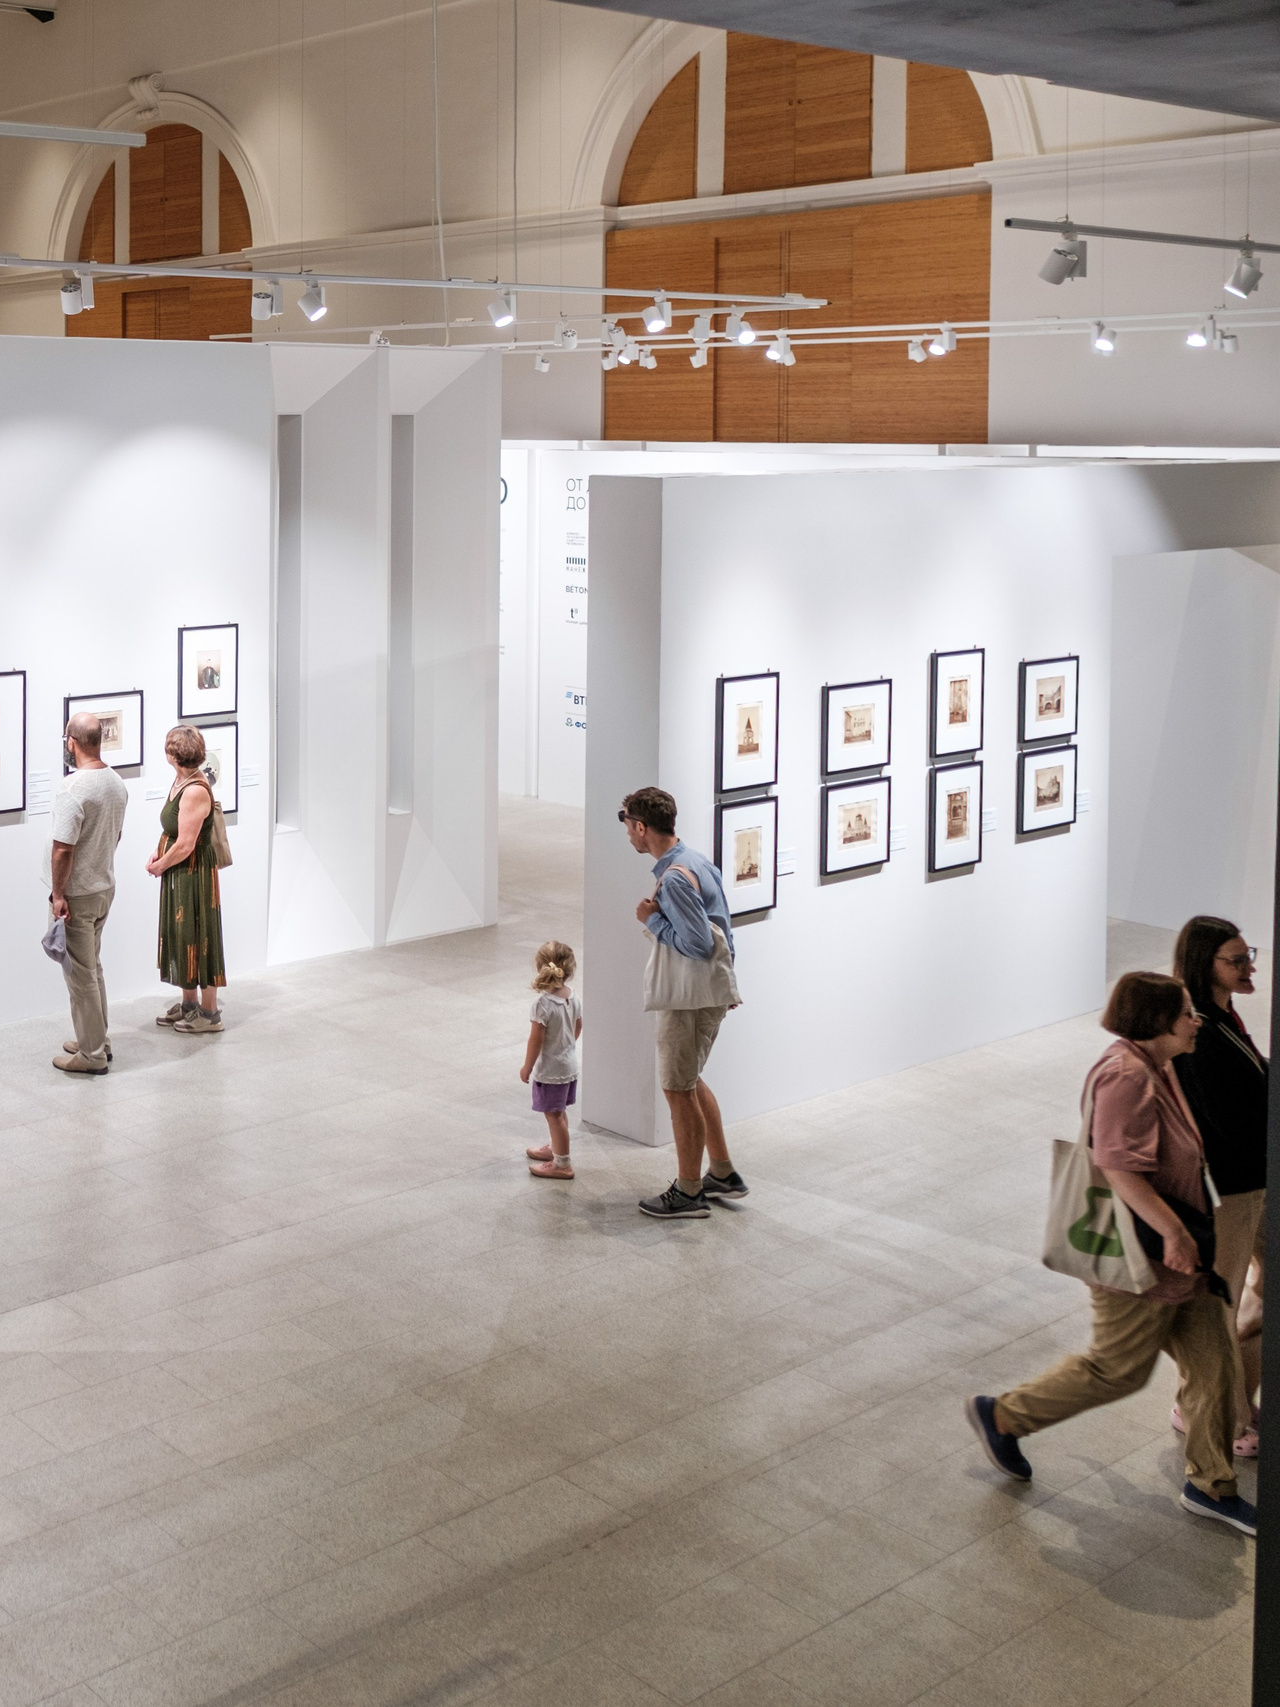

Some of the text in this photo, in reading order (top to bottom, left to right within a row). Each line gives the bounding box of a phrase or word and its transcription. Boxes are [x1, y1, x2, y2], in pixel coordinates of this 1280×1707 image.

[566, 478, 583, 492] ОТ
[566, 496, 586, 511] ДО
[573, 695, 587, 706] ВТ
